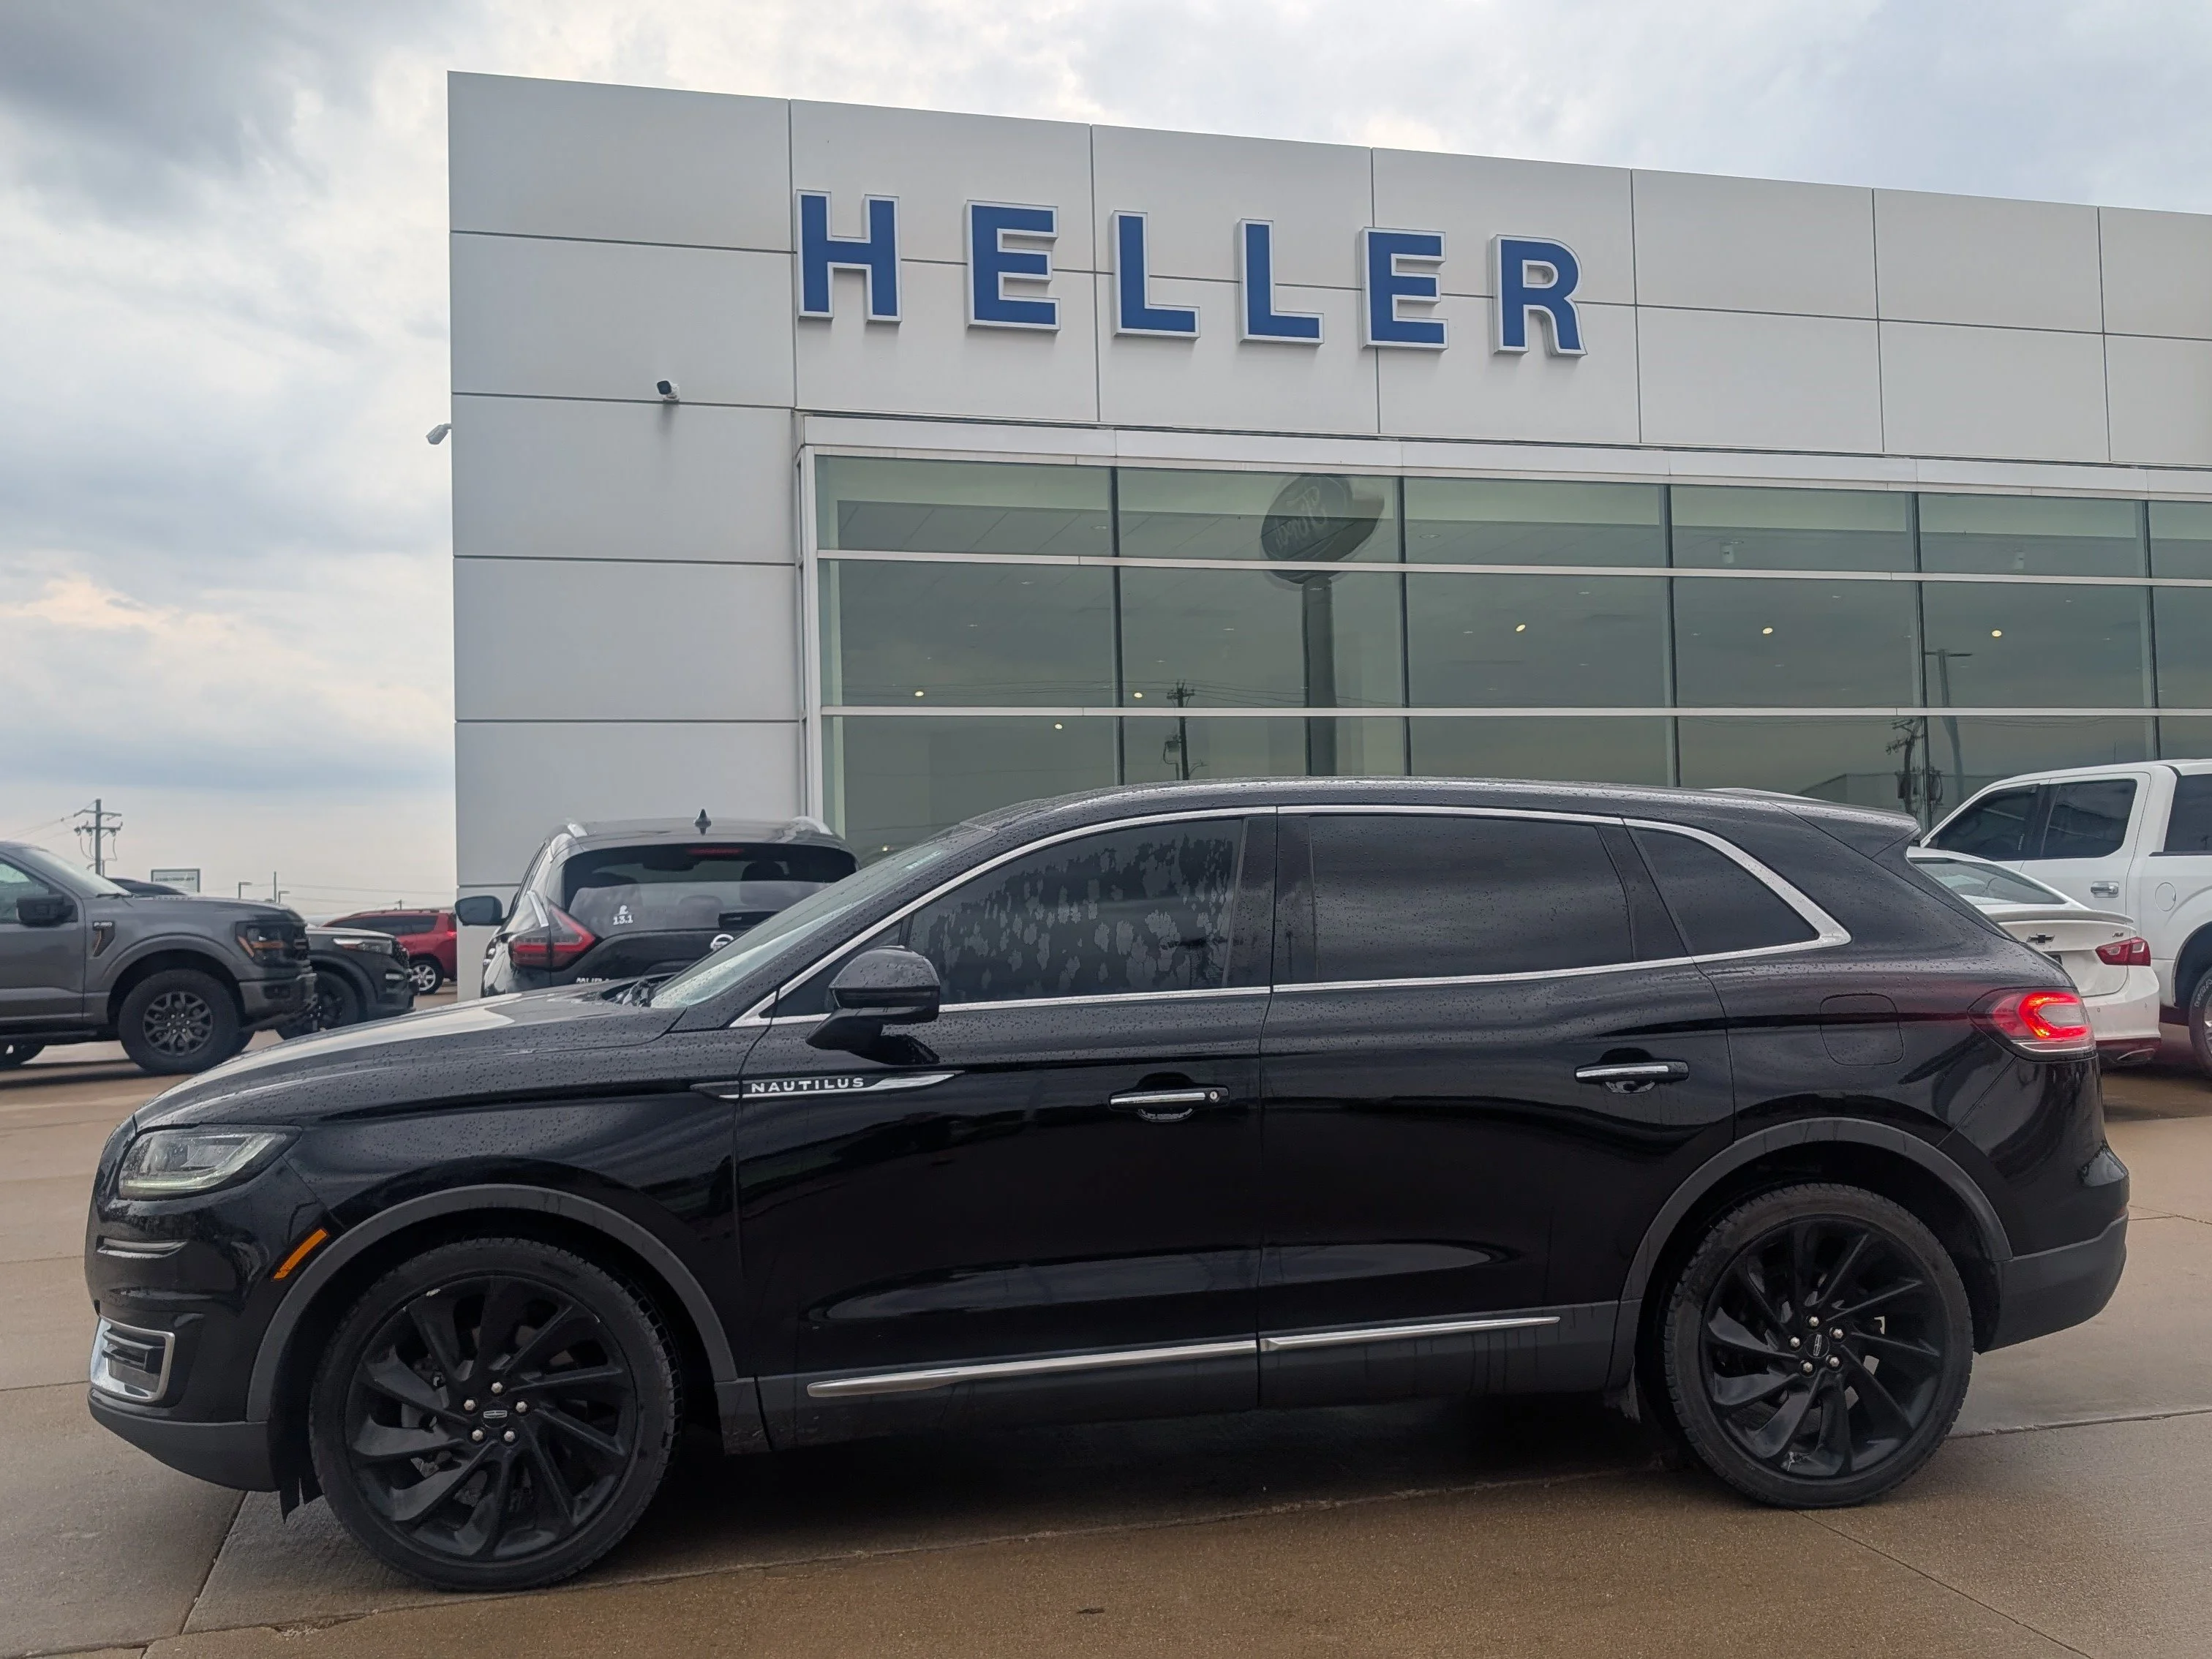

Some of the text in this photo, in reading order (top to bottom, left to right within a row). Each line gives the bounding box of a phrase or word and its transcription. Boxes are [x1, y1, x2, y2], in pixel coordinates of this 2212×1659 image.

[794, 188, 1588, 358] HELLER
[613, 914, 633, 925] 13.1
[750, 1077, 865, 1094] NAUTILUS
